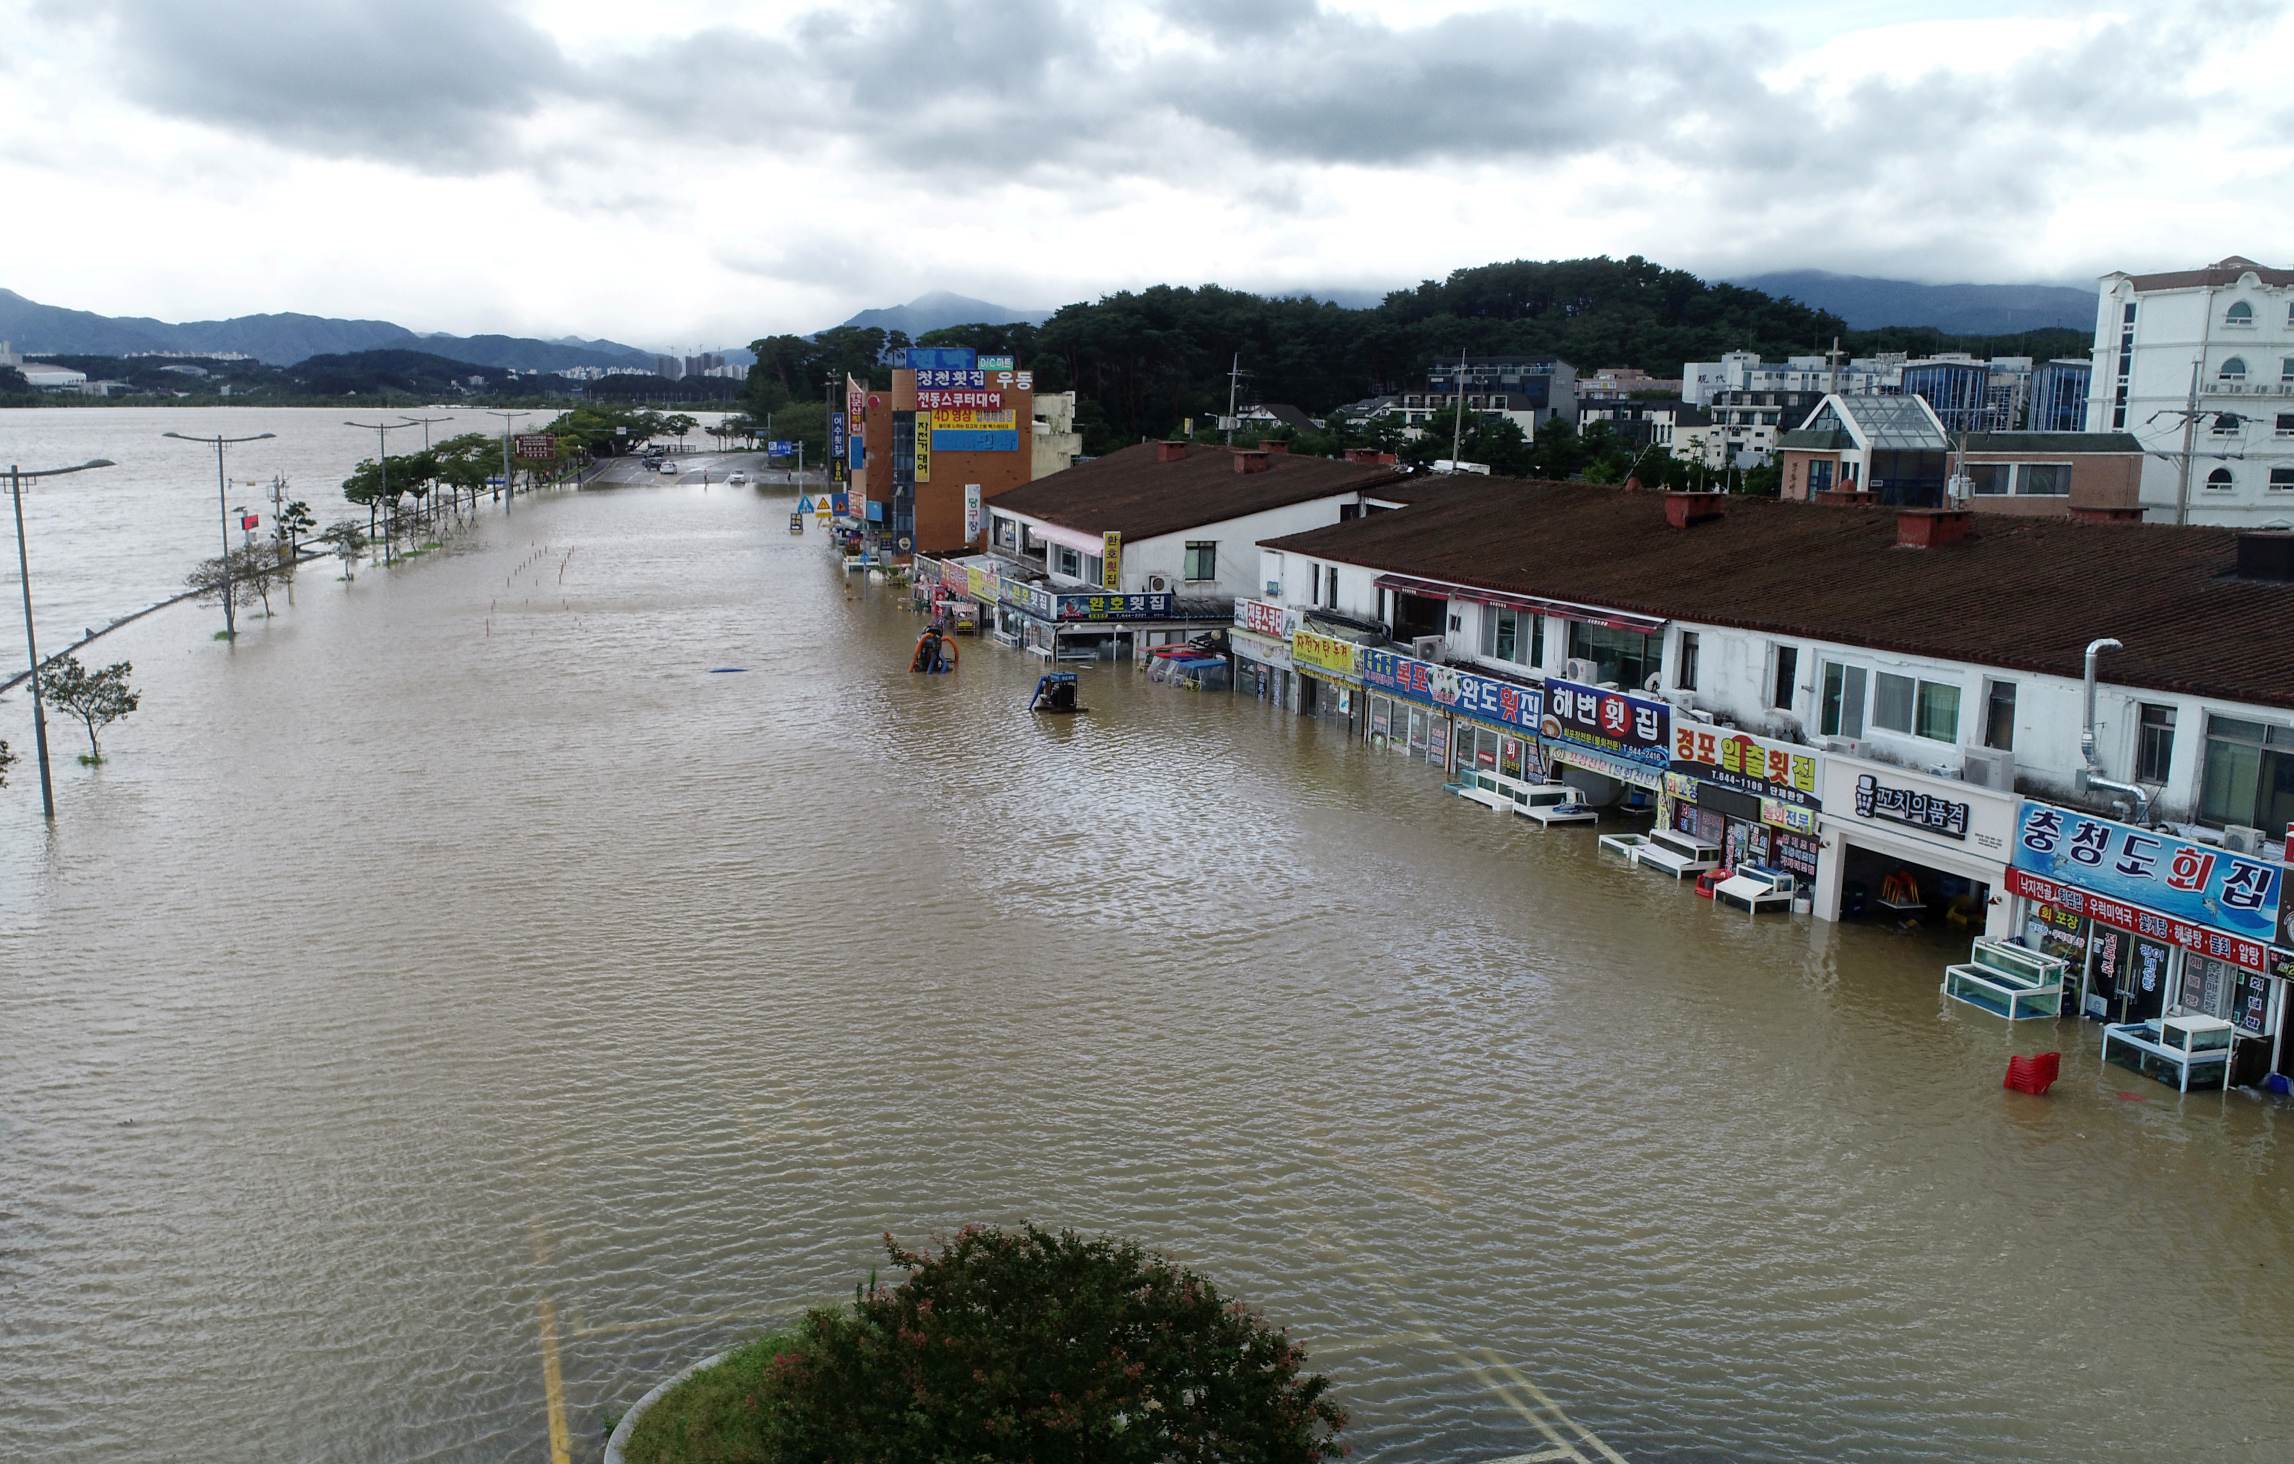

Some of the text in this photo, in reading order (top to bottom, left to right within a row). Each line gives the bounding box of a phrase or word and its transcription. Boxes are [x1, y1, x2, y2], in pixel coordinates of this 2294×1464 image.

[918, 370, 984, 386] 청천횟집
[997, 372, 1033, 390] 우동
[918, 392, 1000, 408] 전동스쿠터대여
[934, 409, 949, 422] 4D
[1397, 660, 1428, 692] 목포
[1461, 677, 1540, 729] 완도횟집
[1553, 687, 1658, 740] 해변횟집
[1877, 787, 1965, 833] 꼬치의품격
[2020, 876, 2052, 900] 낙지전골
[2238, 943, 2260, 966] 알탕
[2055, 912, 2079, 929] 포장
